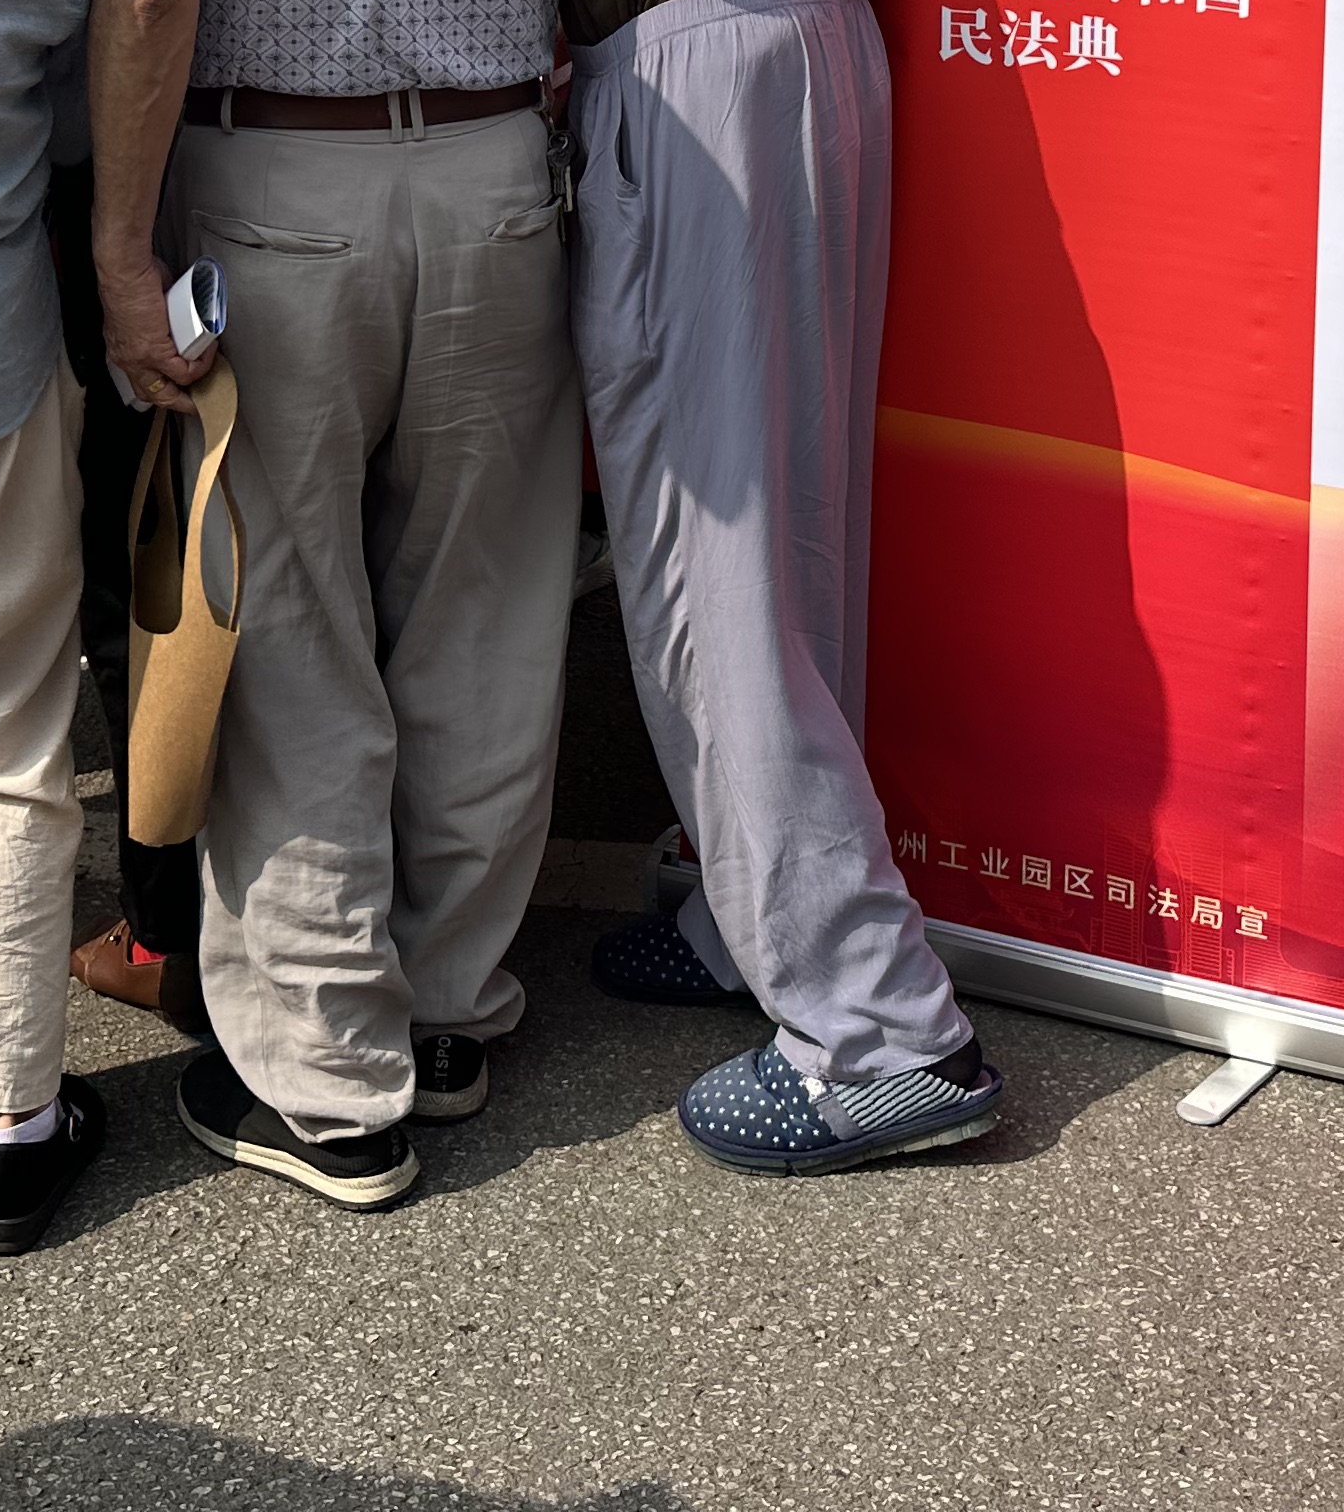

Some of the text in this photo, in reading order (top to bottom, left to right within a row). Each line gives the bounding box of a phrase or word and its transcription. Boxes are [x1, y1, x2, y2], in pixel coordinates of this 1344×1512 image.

[938, 5, 1123, 77] 民法典
[898, 829, 1271, 940] 州工业园区司法局宣
